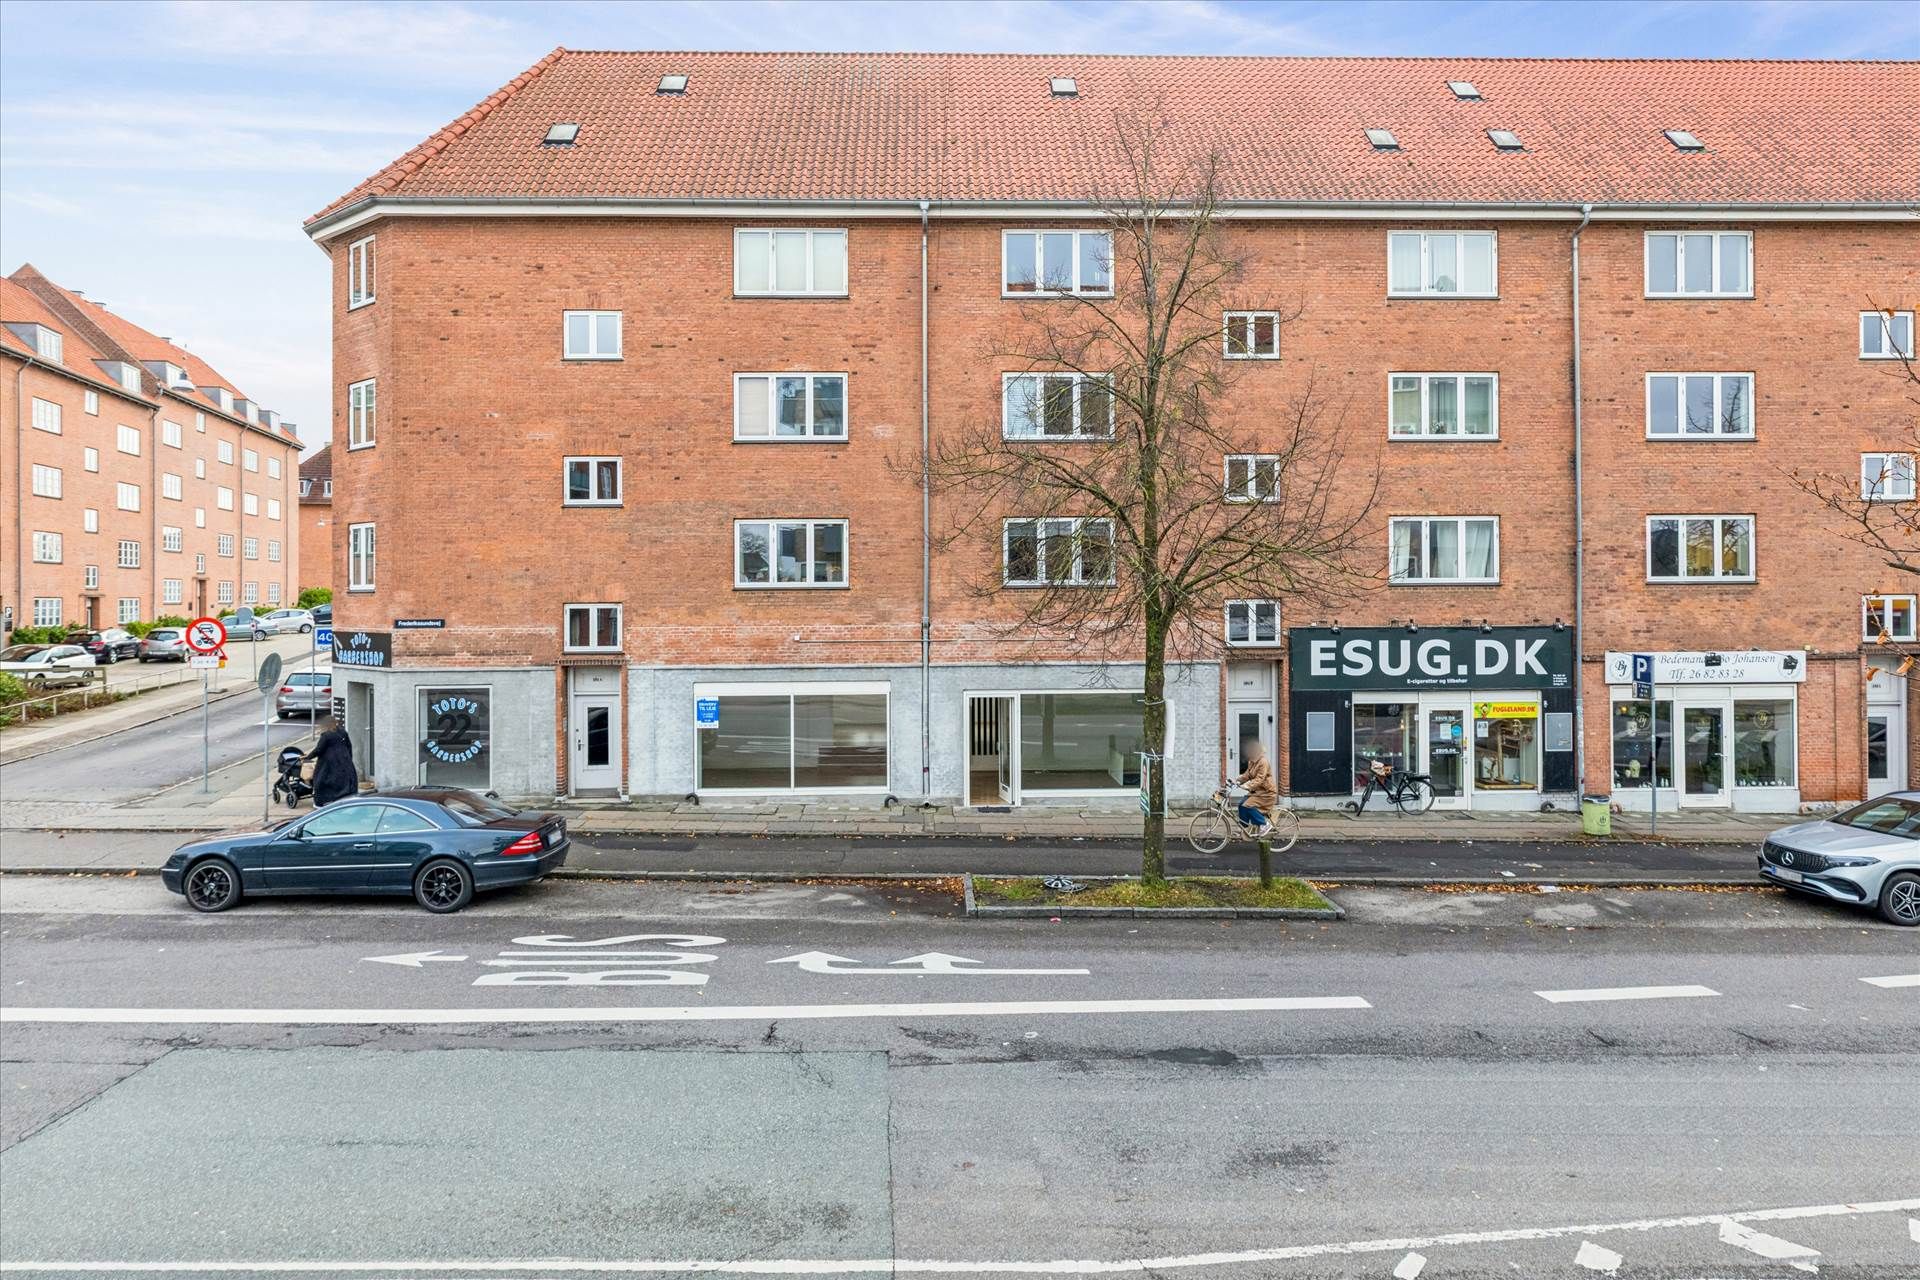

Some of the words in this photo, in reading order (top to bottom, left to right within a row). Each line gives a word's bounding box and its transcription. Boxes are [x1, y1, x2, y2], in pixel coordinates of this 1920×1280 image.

[350, 632, 371, 648] TOTO'S
[338, 650, 384, 666] BARBERSHOP
[1311, 639, 1548, 676] ESUG.DK
[1732, 654, 1776, 665] Johansen
[1637, 658, 1648, 679] P
[1689, 669, 1701, 679] 26
[1703, 669, 1715, 679] 82
[1732, 669, 1745, 679] 28
[431, 697, 478, 715] TOTO'S
[427, 741, 482, 763] BARBERSHOP
[471, 934, 727, 986] BUS
